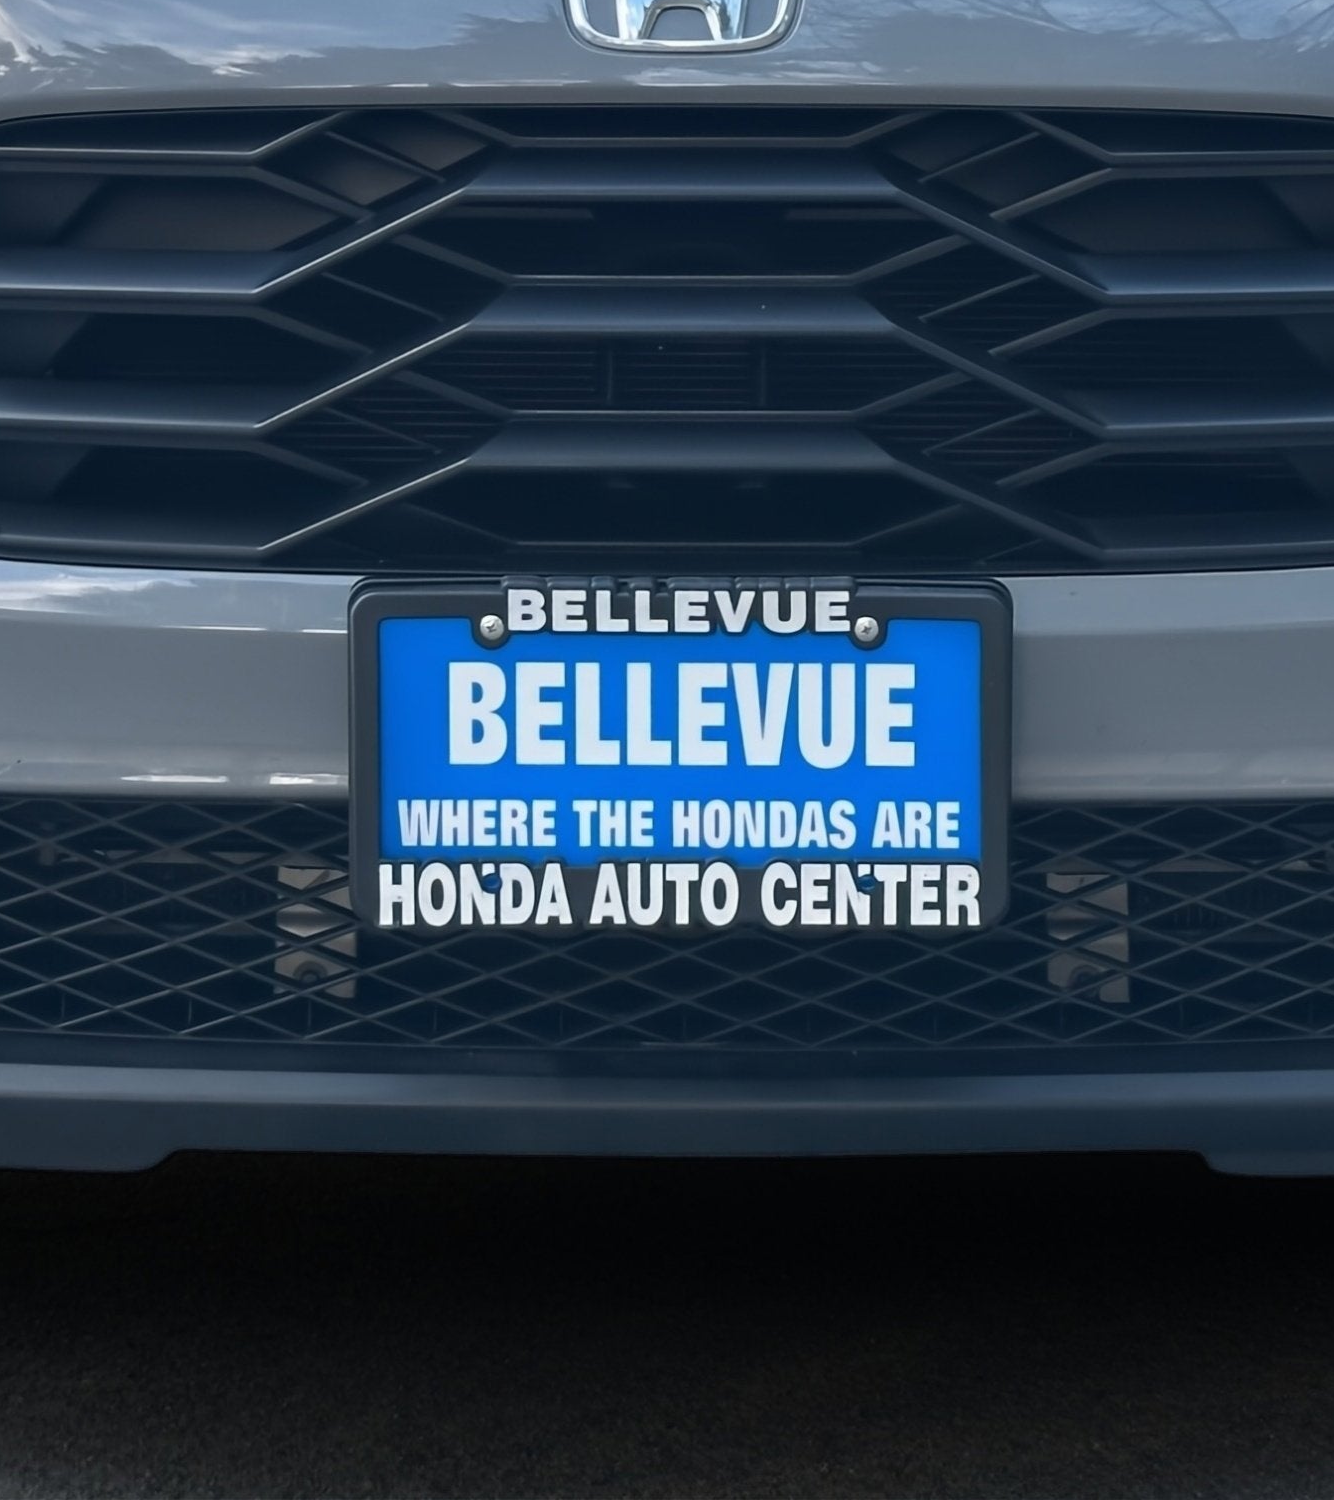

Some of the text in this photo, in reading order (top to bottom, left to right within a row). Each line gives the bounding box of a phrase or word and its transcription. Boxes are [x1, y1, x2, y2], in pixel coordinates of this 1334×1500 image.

[508, 590, 851, 632] BELLEVUE
[449, 662, 916, 769] BELLEVUE
[398, 800, 960, 849] WHERE THE HONDAS ARE
[378, 863, 981, 927] HONDA AUTO CENTER
